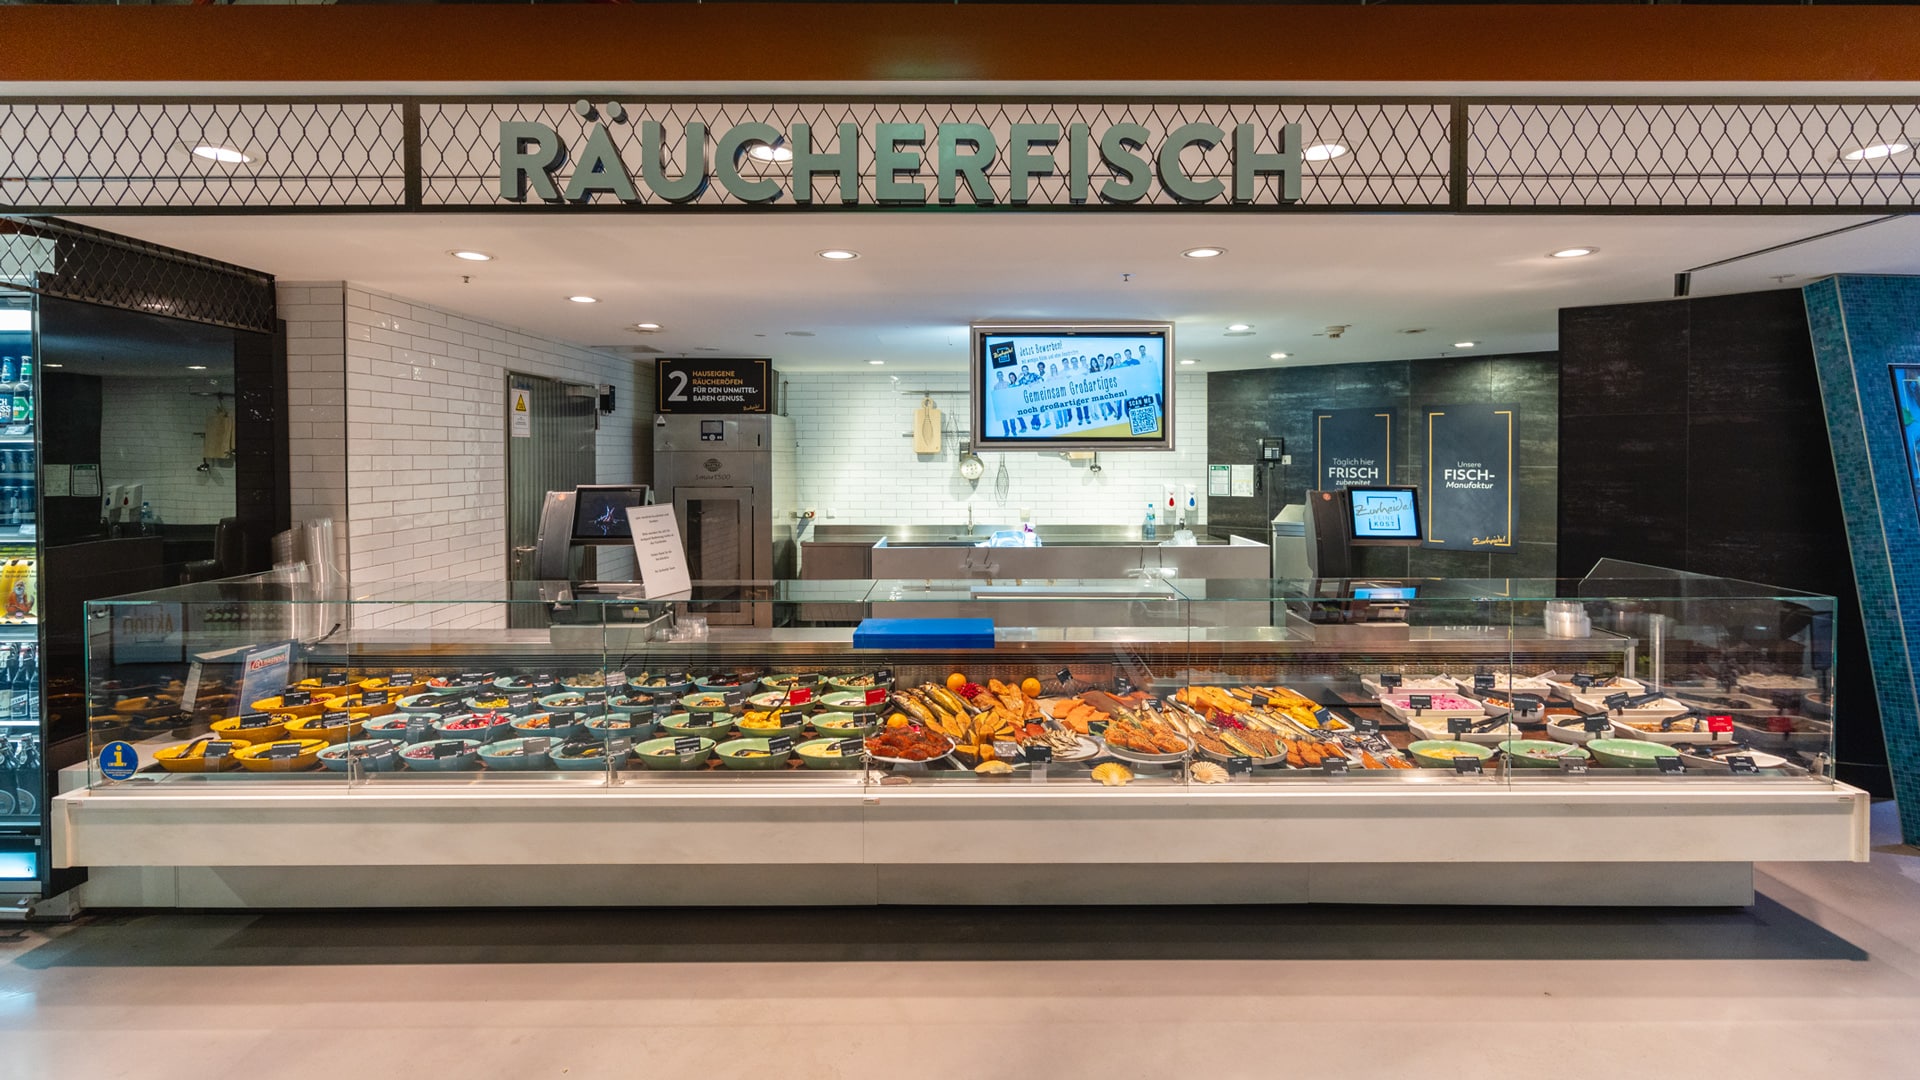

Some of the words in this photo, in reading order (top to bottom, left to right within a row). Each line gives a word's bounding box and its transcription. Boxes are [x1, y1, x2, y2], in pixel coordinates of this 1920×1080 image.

[499, 99, 1303, 205] RÄUCHERFISCH
[1019, 345, 1034, 357] Jetzt
[1035, 340, 1063, 354] Bewerben!
[668, 370, 688, 402] 2
[693, 385, 707, 393] FÜR
[1023, 384, 1067, 404] Gemeinsam
[1069, 376, 1118, 395] Großartiges
[1017, 405, 1039, 416] noch
[1039, 396, 1089, 413] großartiger
[1091, 390, 1128, 402] machen!
[1332, 457, 1358, 466] Täglich
[1359, 458, 1375, 466] hier
[1328, 467, 1379, 479] FRISCH
[1444, 469, 1496, 481] FISCH-
[1445, 481, 1494, 490] Manufaktur
